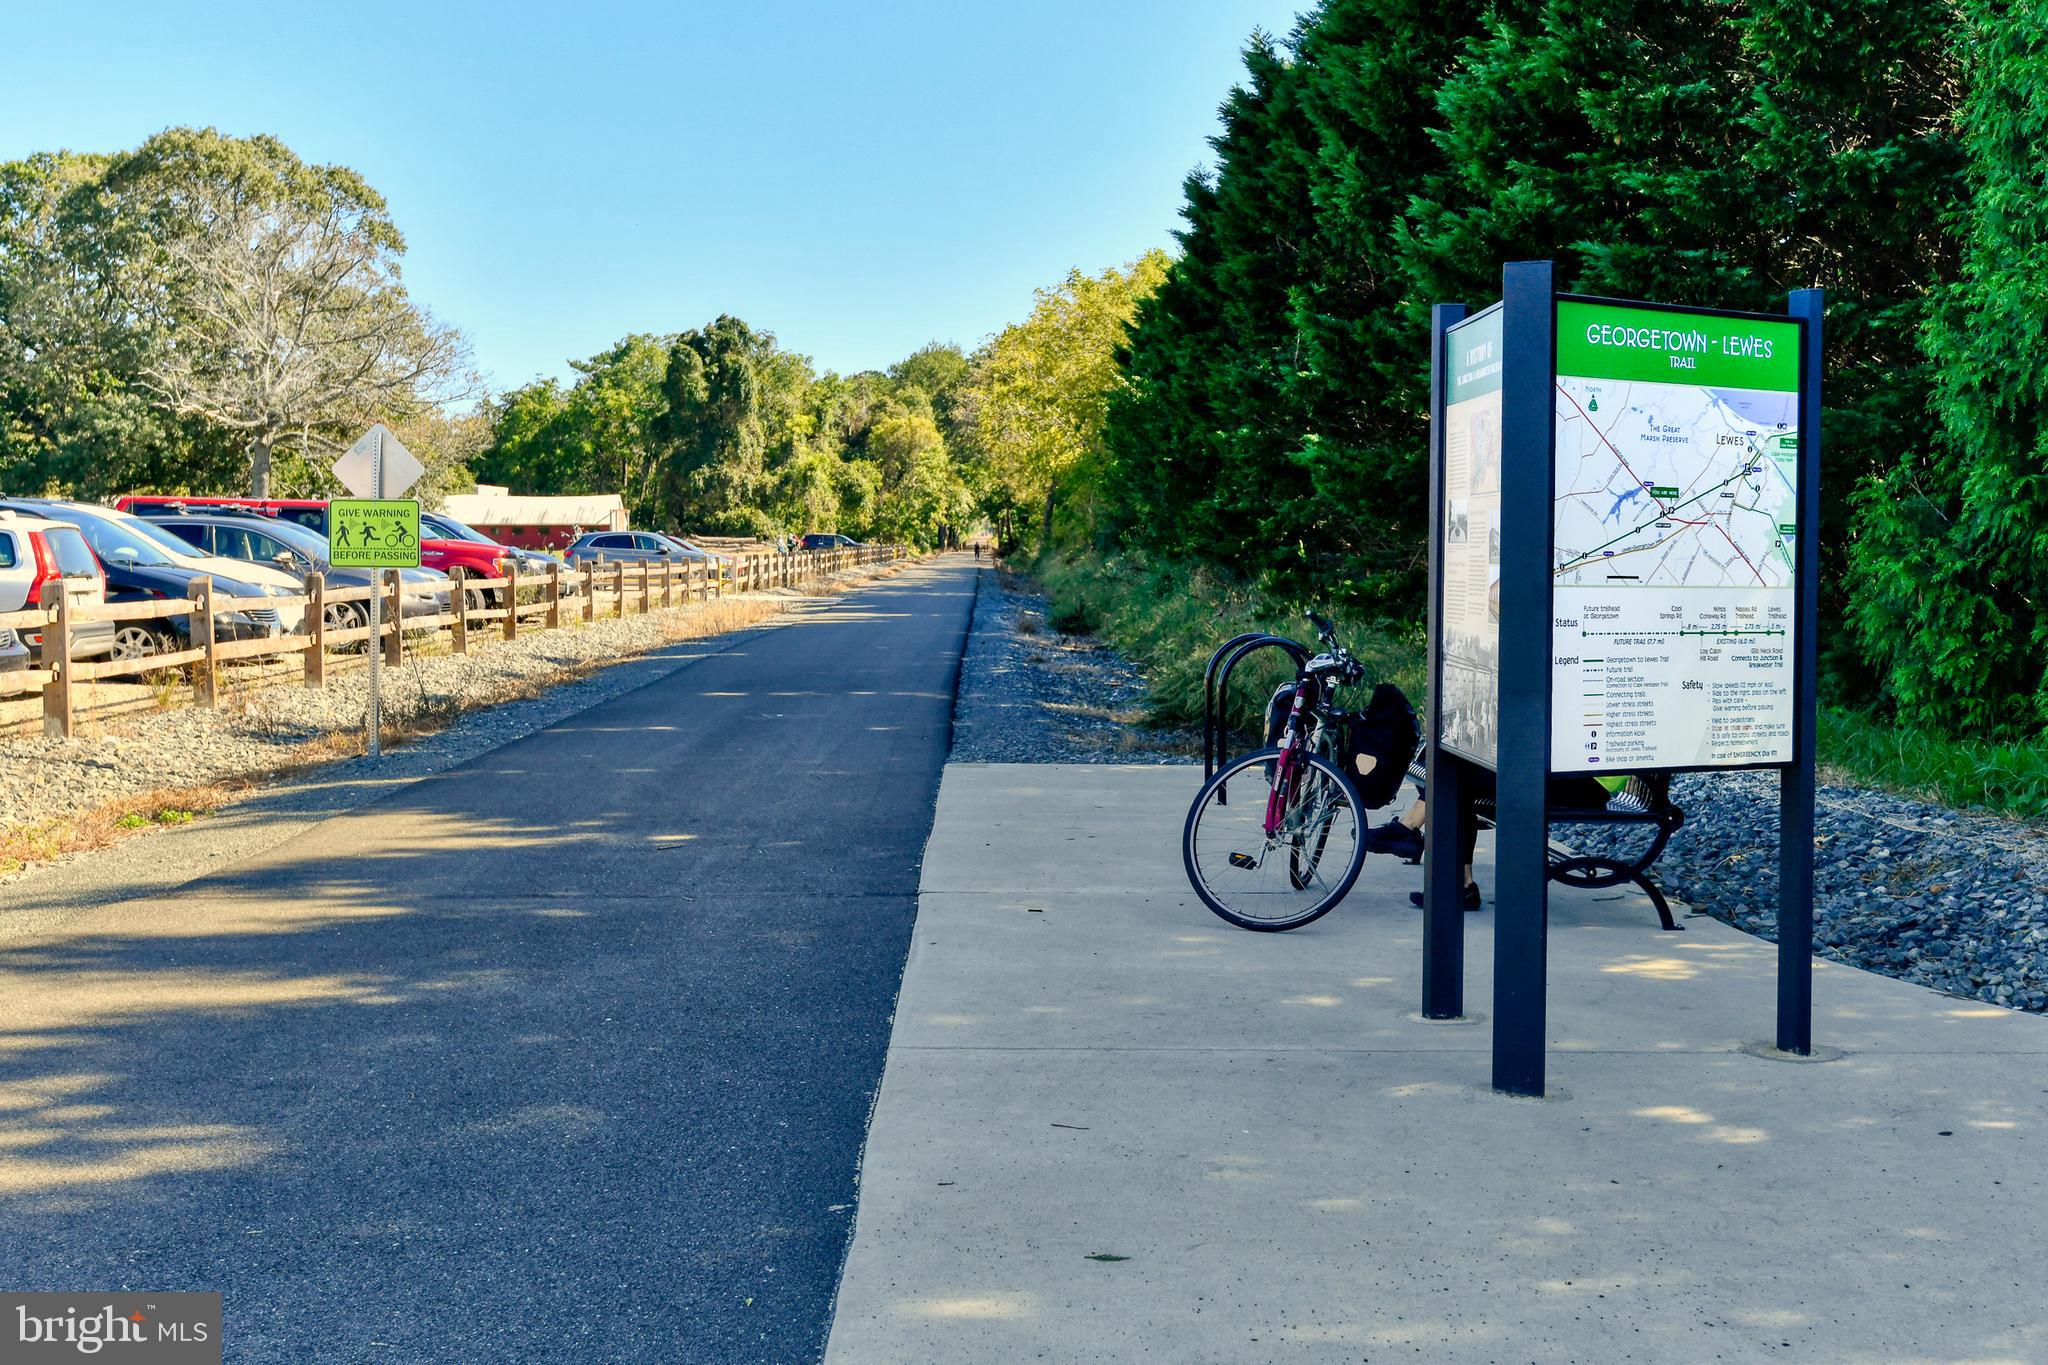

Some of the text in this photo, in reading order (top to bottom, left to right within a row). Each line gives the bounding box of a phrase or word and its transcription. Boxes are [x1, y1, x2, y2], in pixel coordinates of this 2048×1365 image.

[1586, 324, 1707, 354] GEORGETOWN
[1722, 335, 1774, 358] LEWES
[1669, 356, 1696, 368] TRAIL
[1716, 433, 1744, 446] LEWES
[338, 509, 410, 518] GIVE WARNING
[333, 551, 371, 559] BEFORE
[374, 551, 416, 560] PASSING
[1555, 619, 1578, 628] Status
[1555, 656, 1579, 666] Legend
[1682, 680, 1704, 690] Safety
